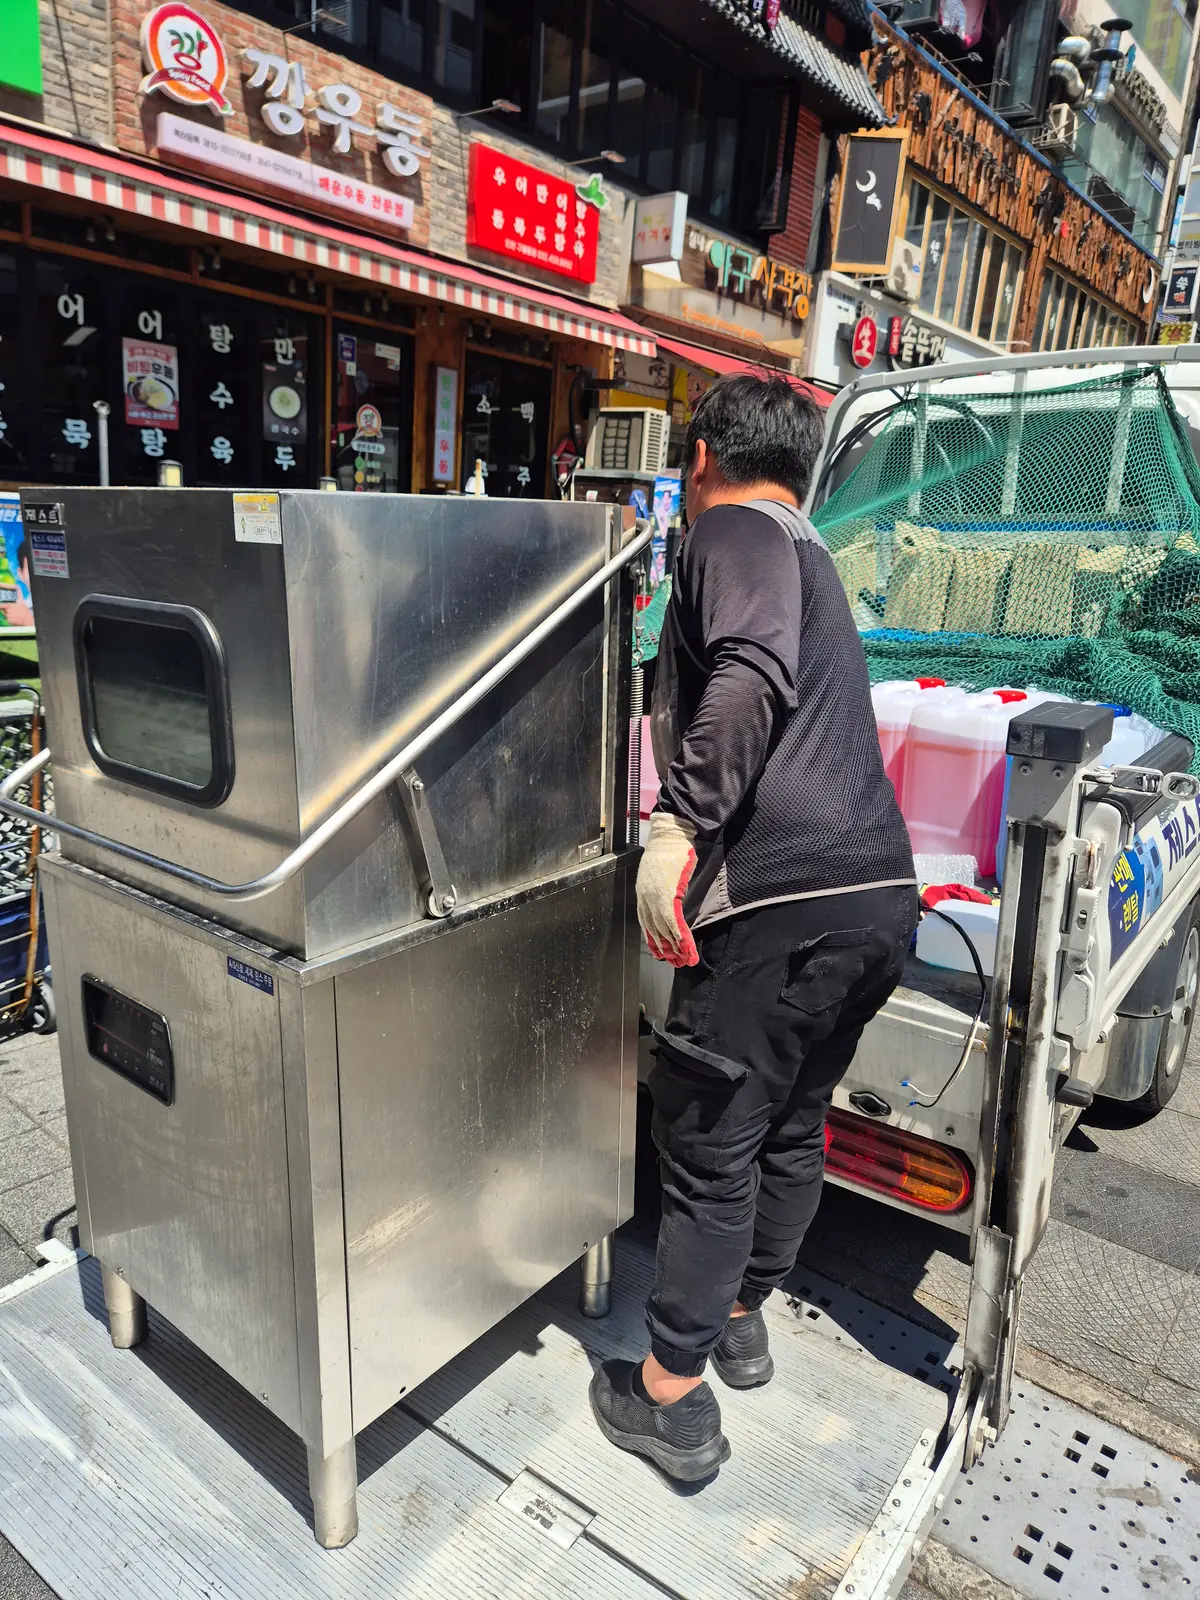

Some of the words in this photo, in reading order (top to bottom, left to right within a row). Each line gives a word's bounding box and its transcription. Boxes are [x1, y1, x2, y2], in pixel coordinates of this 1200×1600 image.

[240, 47, 431, 177] 깡우동
[317, 176, 366, 206] 매운우동
[371, 194, 405, 219] 전문점
[708, 240, 753, 294] 야구
[754, 256, 814, 320] 사격장
[25, 509, 59, 524] 제스트
